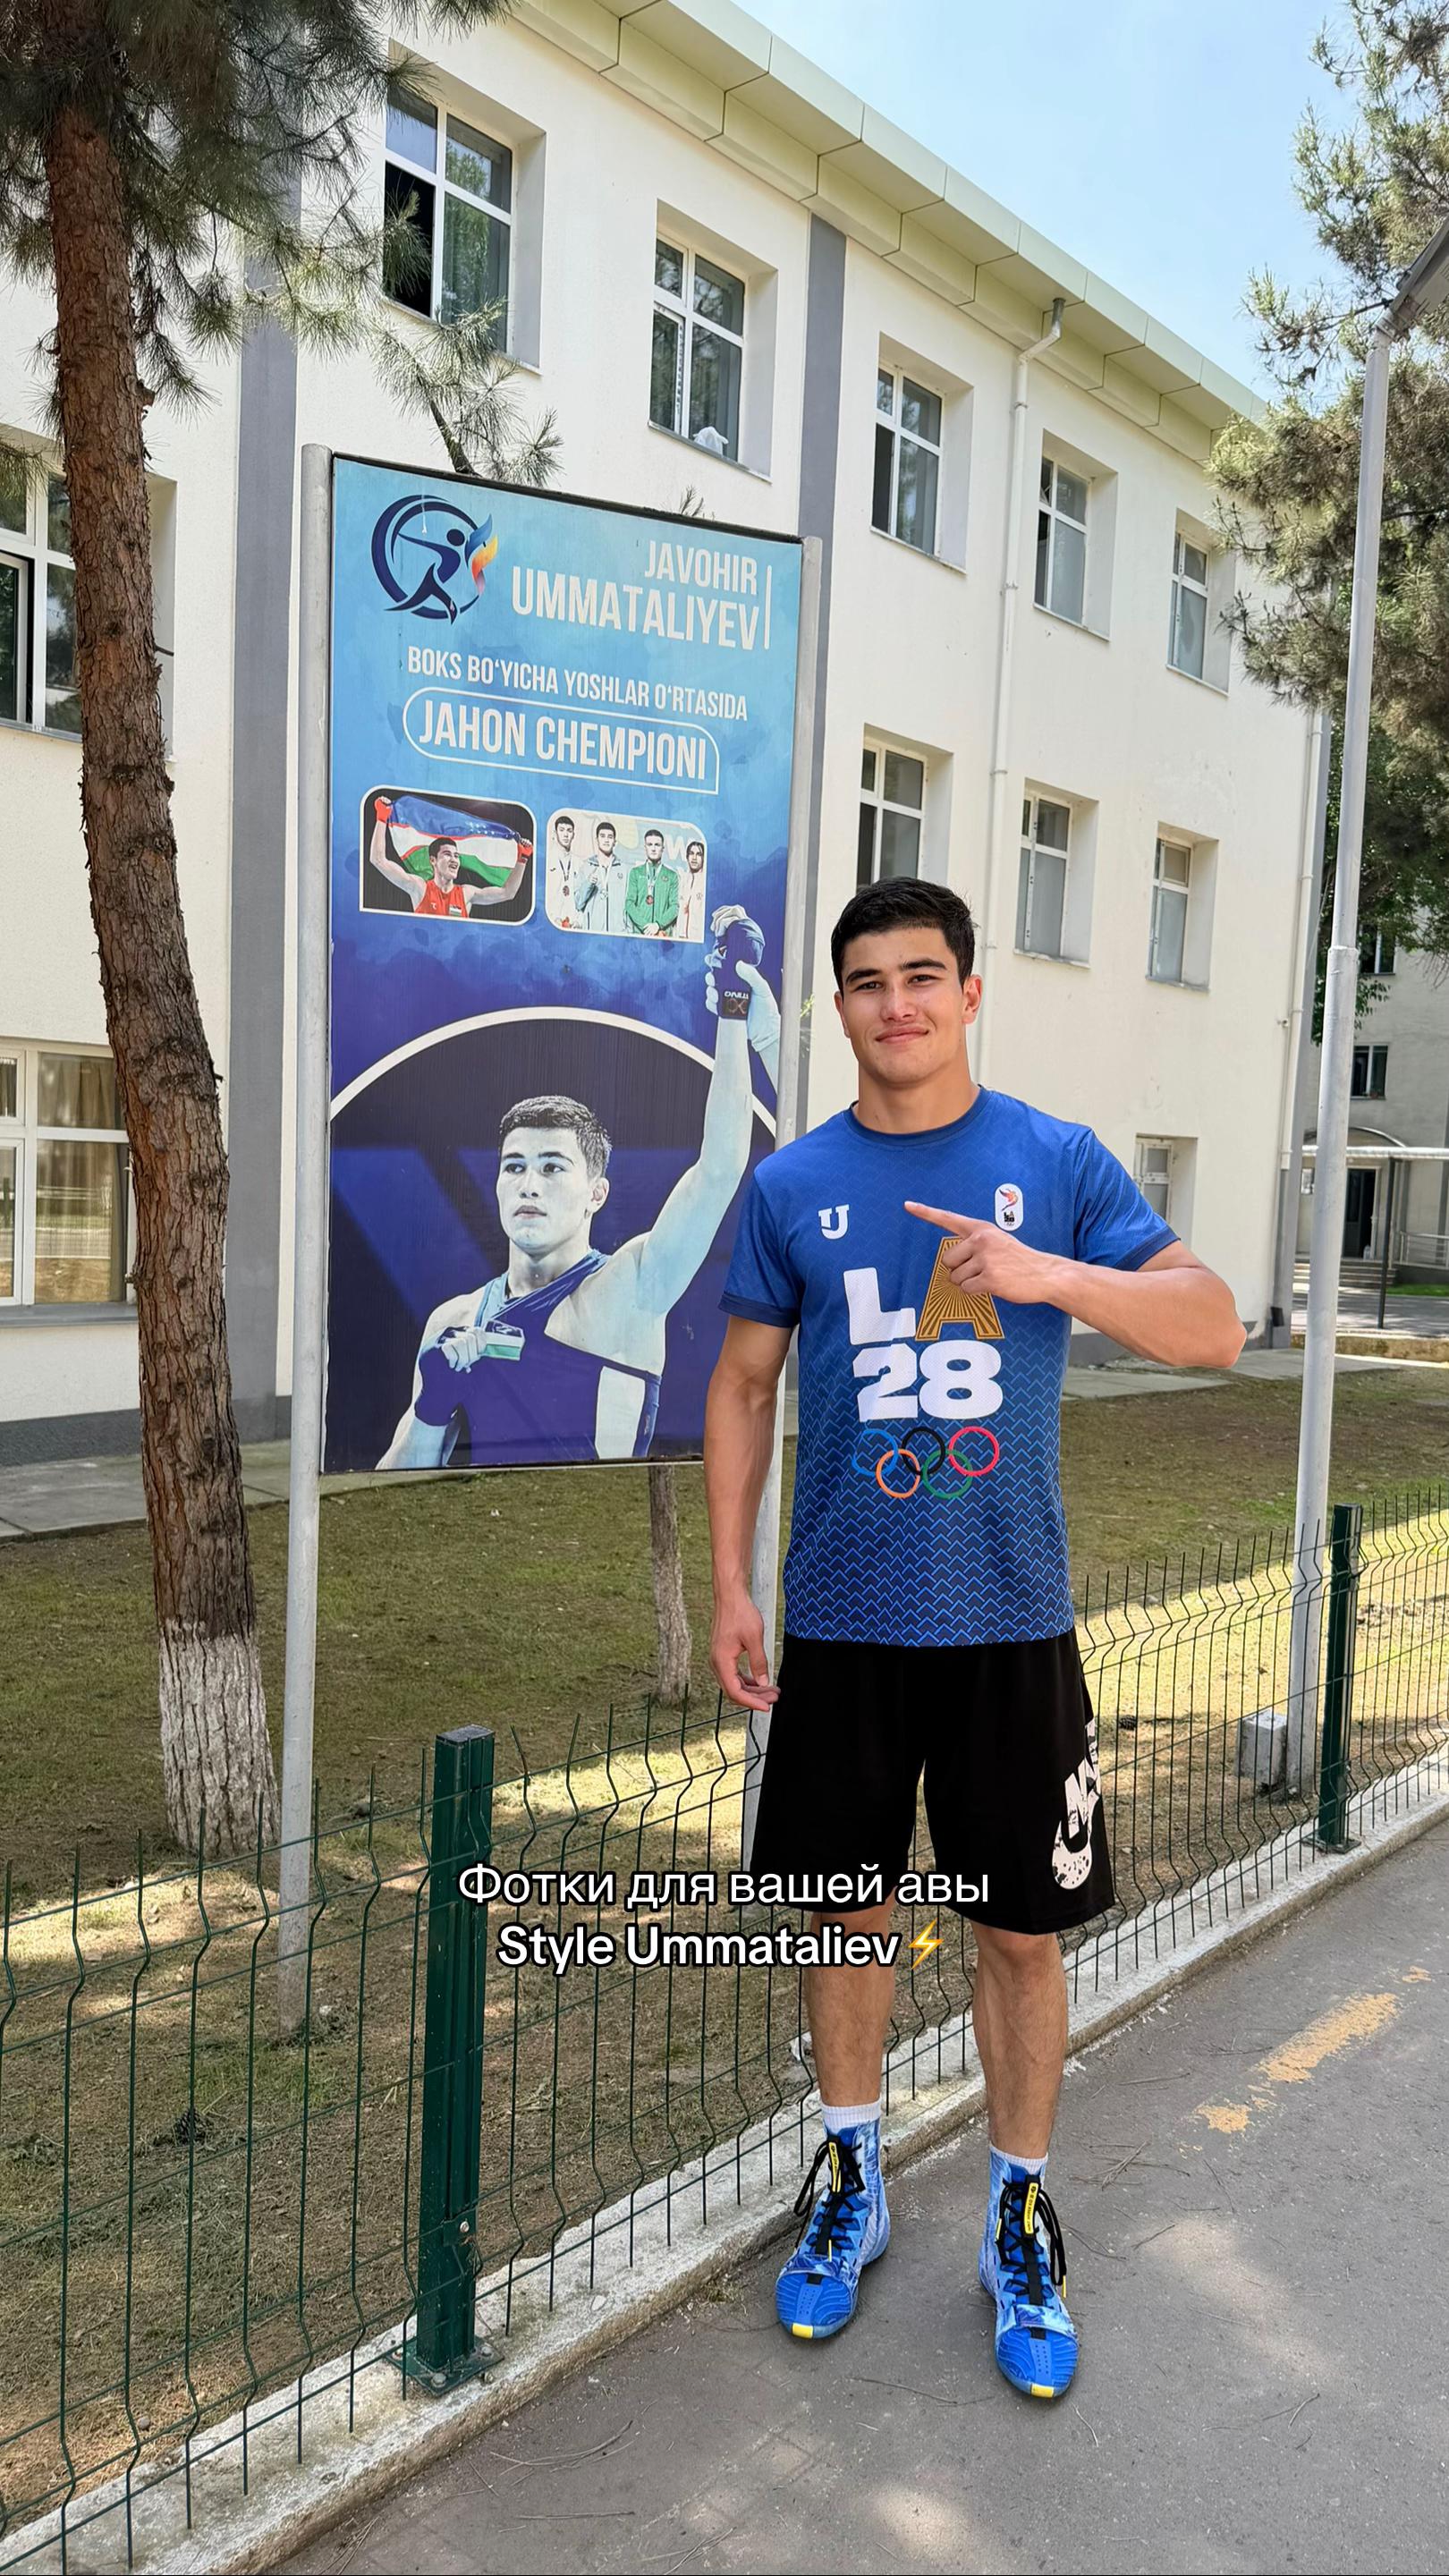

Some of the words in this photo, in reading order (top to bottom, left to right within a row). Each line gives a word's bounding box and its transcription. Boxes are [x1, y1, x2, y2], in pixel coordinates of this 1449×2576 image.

[512, 565, 759, 650] UMMATALIYEV
[644, 540, 758, 596] JAVOHIR
[408, 646, 462, 680] BOKS
[564, 669, 649, 708] YOSHLAR
[419, 699, 526, 757] JAHON
[536, 716, 707, 780] CHEMPIONI
[843, 1236, 1005, 1345] LA
[852, 1340, 1004, 1422] 28
